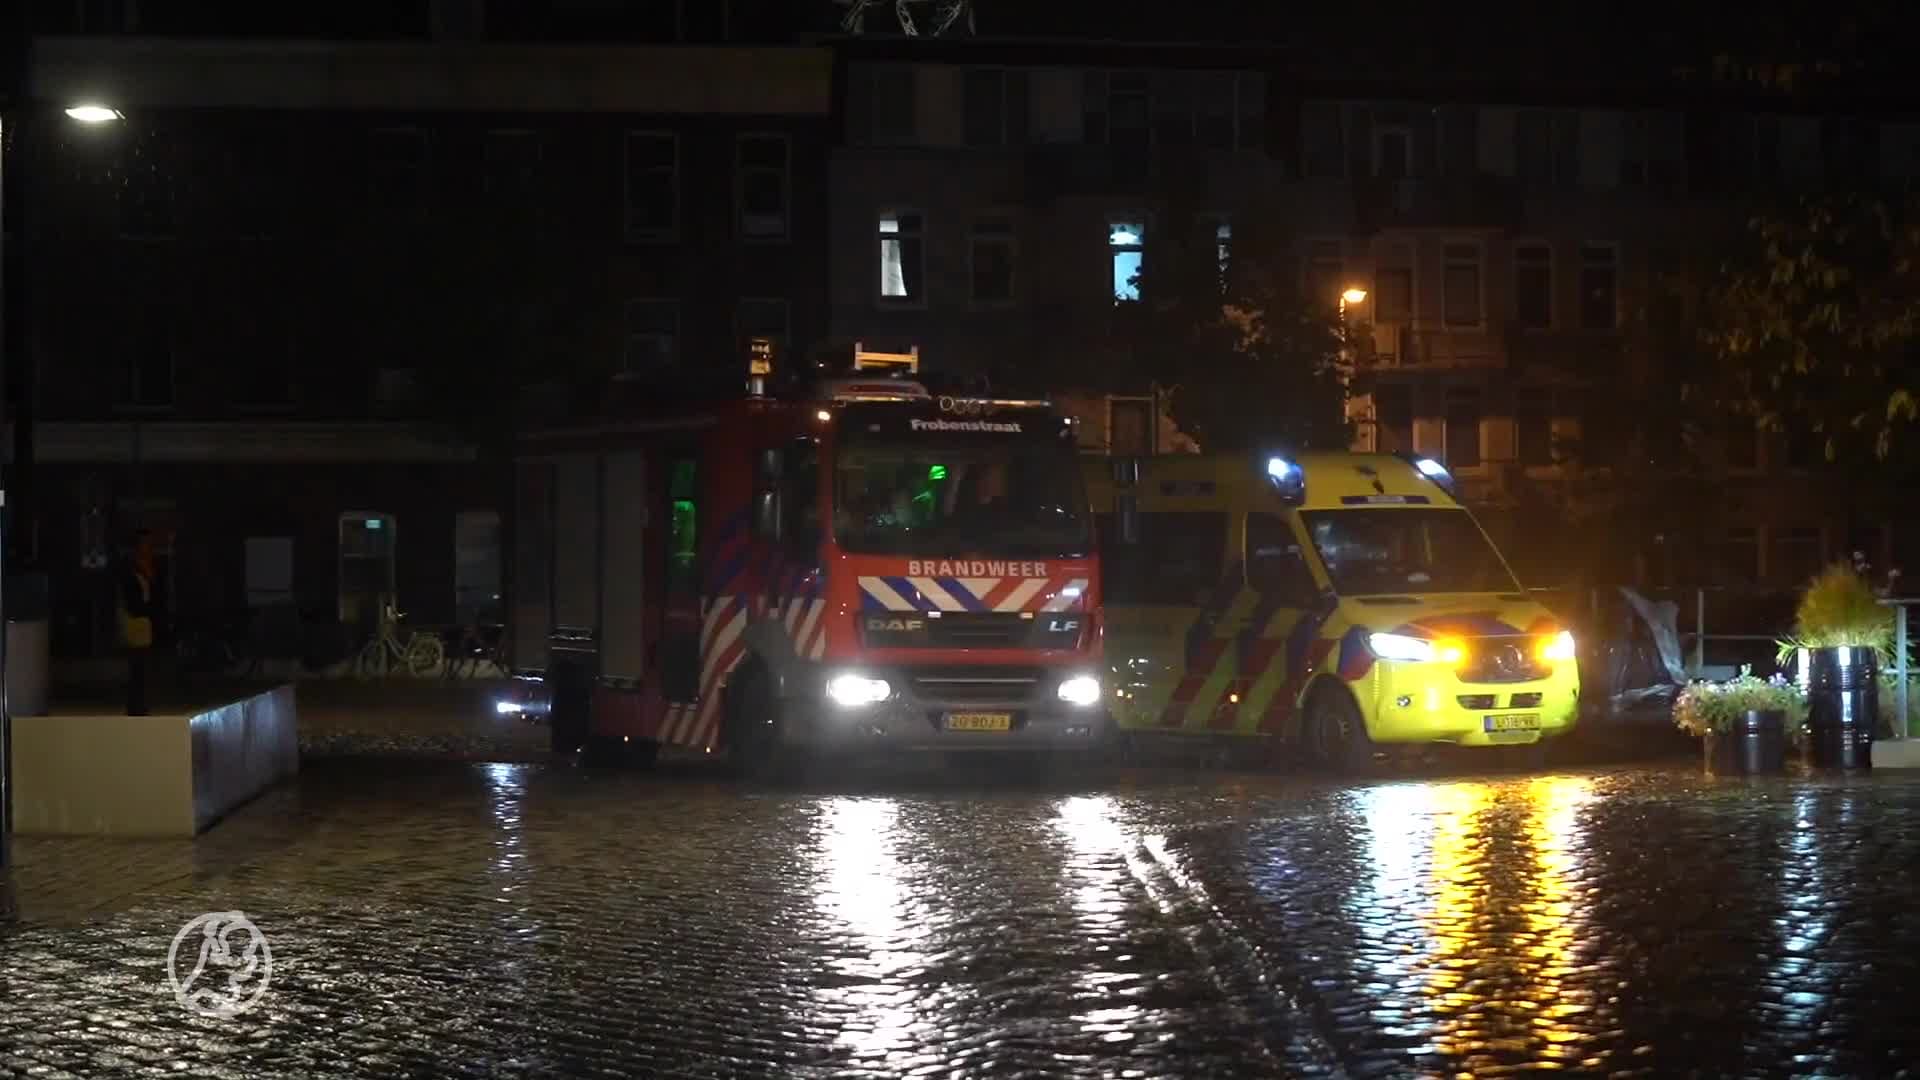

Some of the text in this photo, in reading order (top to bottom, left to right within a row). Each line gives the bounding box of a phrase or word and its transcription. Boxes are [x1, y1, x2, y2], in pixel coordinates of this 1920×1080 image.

[911, 419, 1022, 433] Frobenstraat
[908, 561, 1047, 577] BRANDWEER
[868, 619, 923, 632] DAF
[1049, 621, 1078, 632] LF
